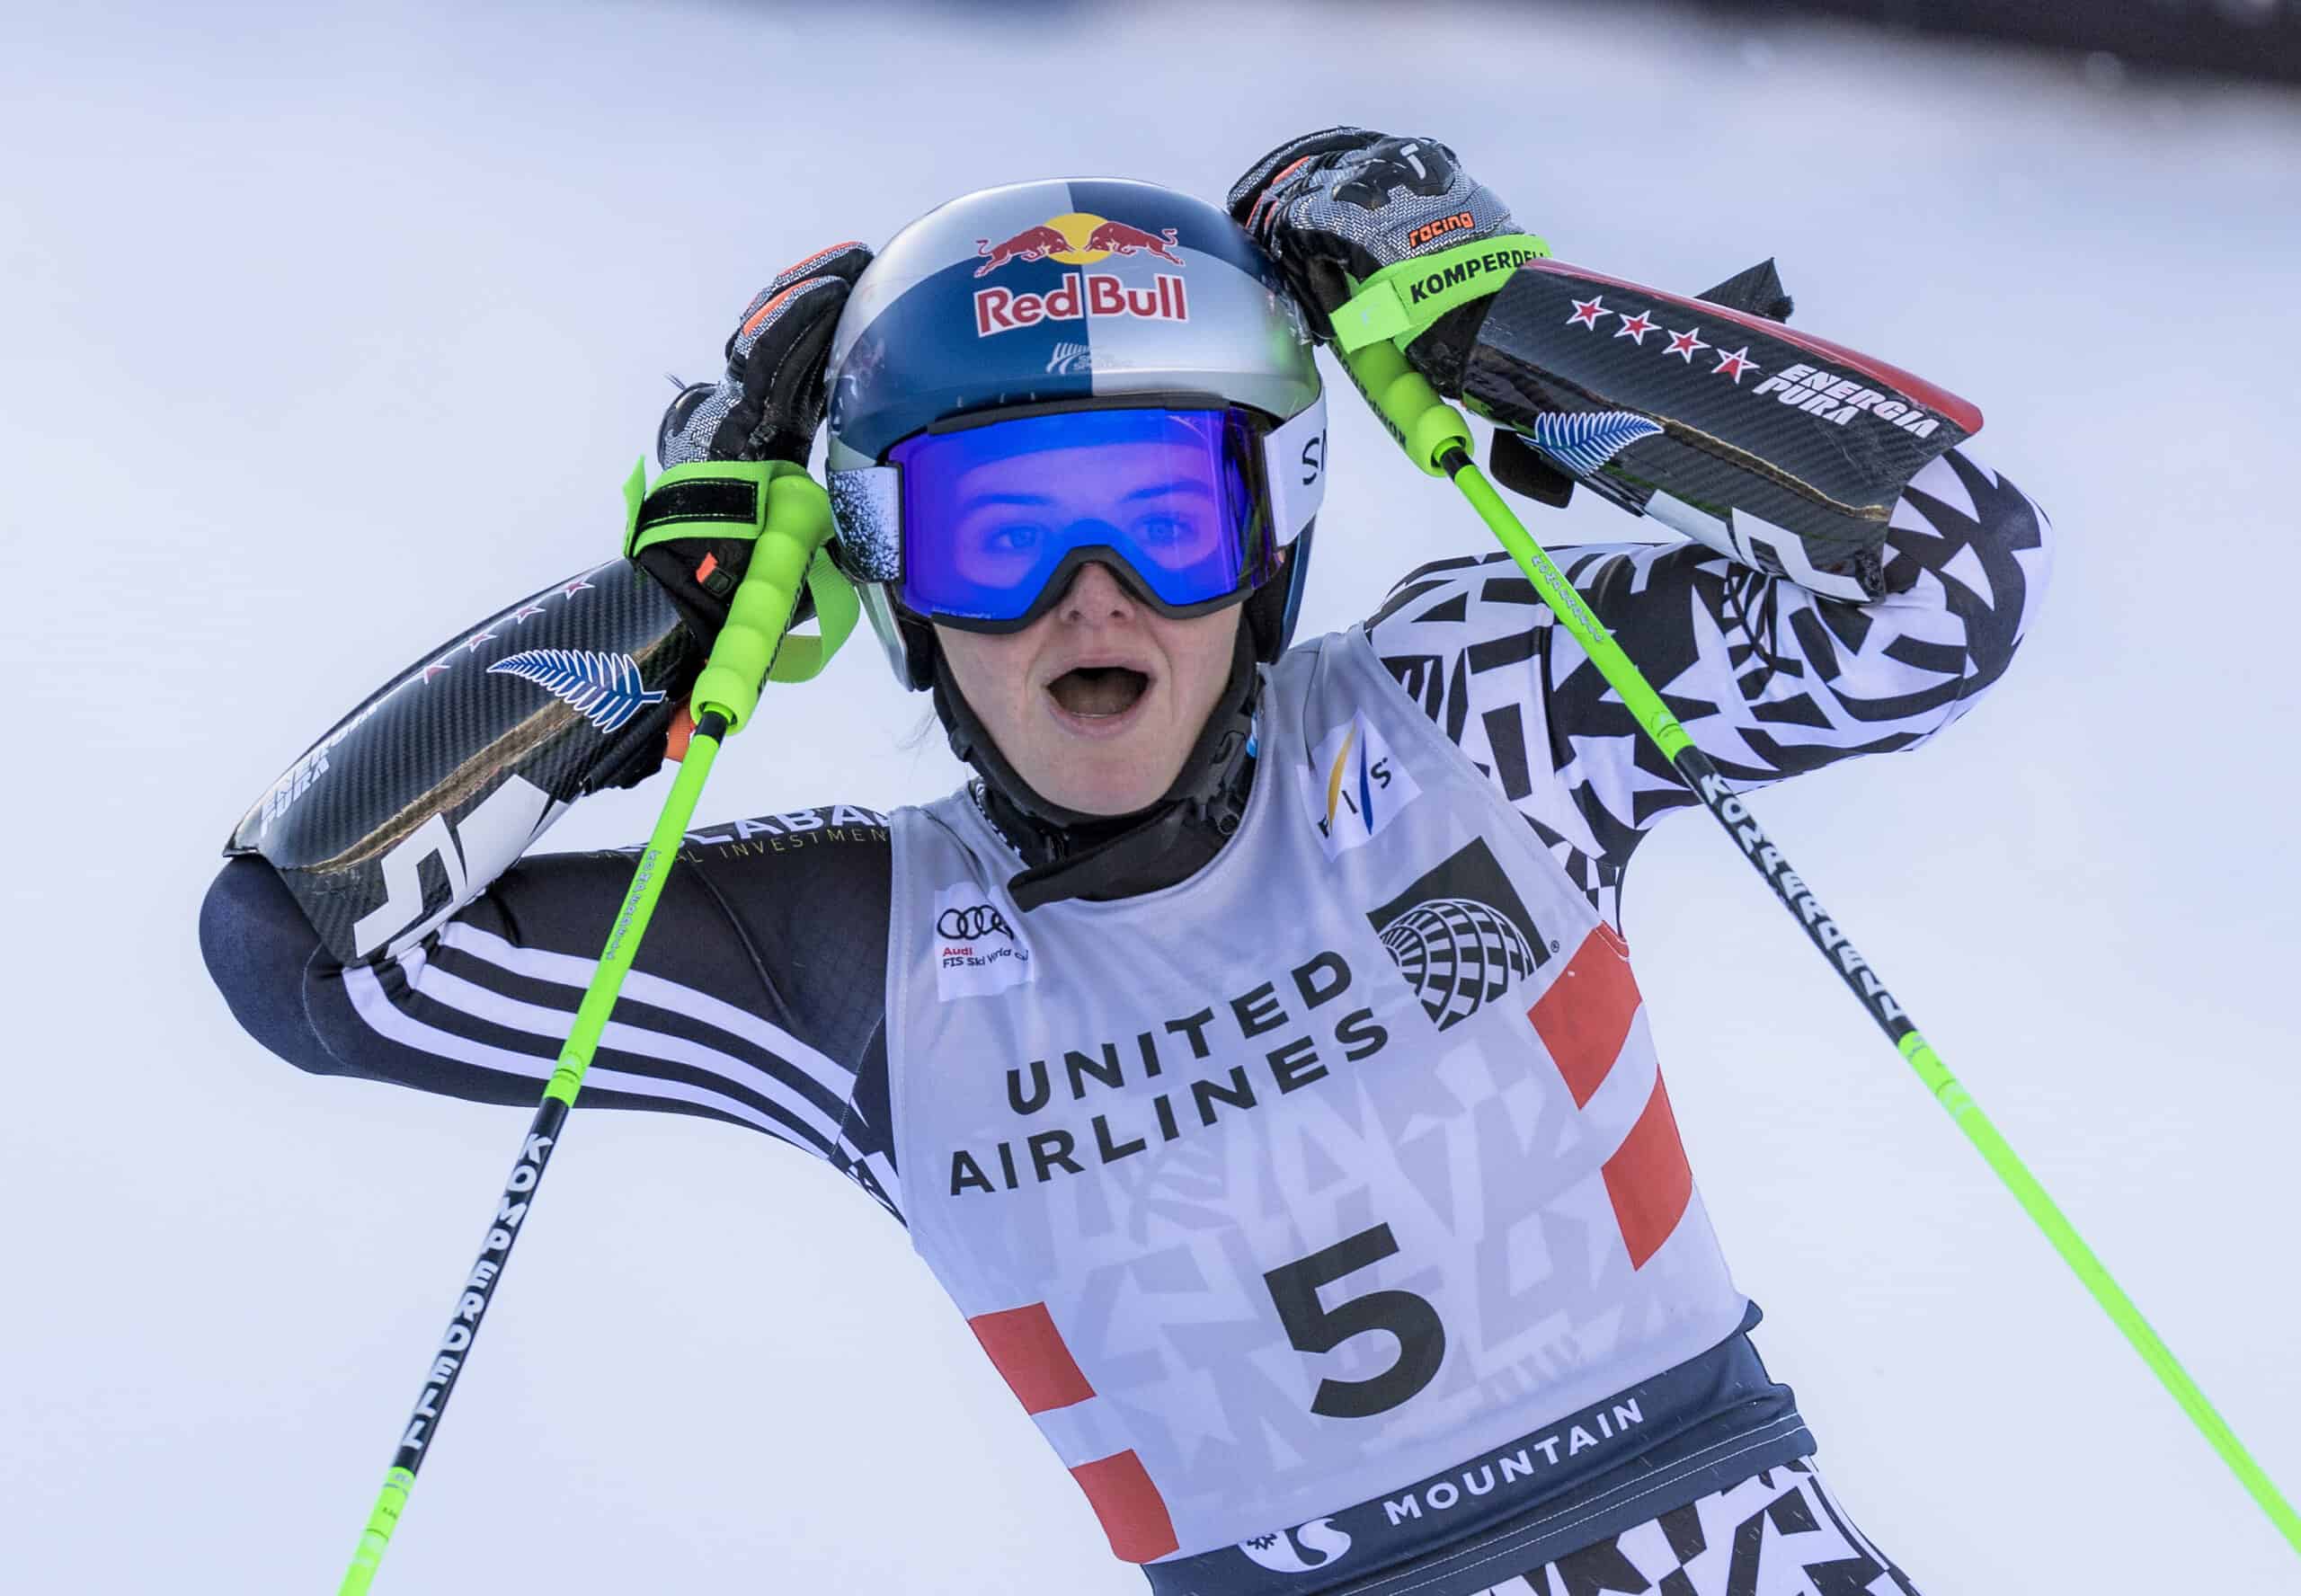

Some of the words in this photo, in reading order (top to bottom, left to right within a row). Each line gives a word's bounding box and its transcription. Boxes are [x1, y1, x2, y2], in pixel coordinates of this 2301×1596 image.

[1409, 211, 1474, 249] racing
[974, 273, 1083, 338] Red
[1088, 273, 1189, 323] Bull
[1410, 248, 1543, 304] KOMPERDE
[1753, 377, 1860, 425] PURA
[1778, 363, 1941, 439] ENERGIA
[719, 828, 887, 858] INVESTMEN
[1701, 772, 1903, 1022] KOMPERDELL
[943, 947, 973, 957] Audi
[943, 956, 964, 969] FIS
[966, 956, 986, 966] Ski
[1006, 951, 1353, 1116] UNITED
[950, 1007, 1389, 1196] AIRLINES
[402, 1133, 555, 1450] KOMPERDELL
[1263, 1221, 1446, 1418] 5
[1383, 1398, 1644, 1526] MOUNTAIN
